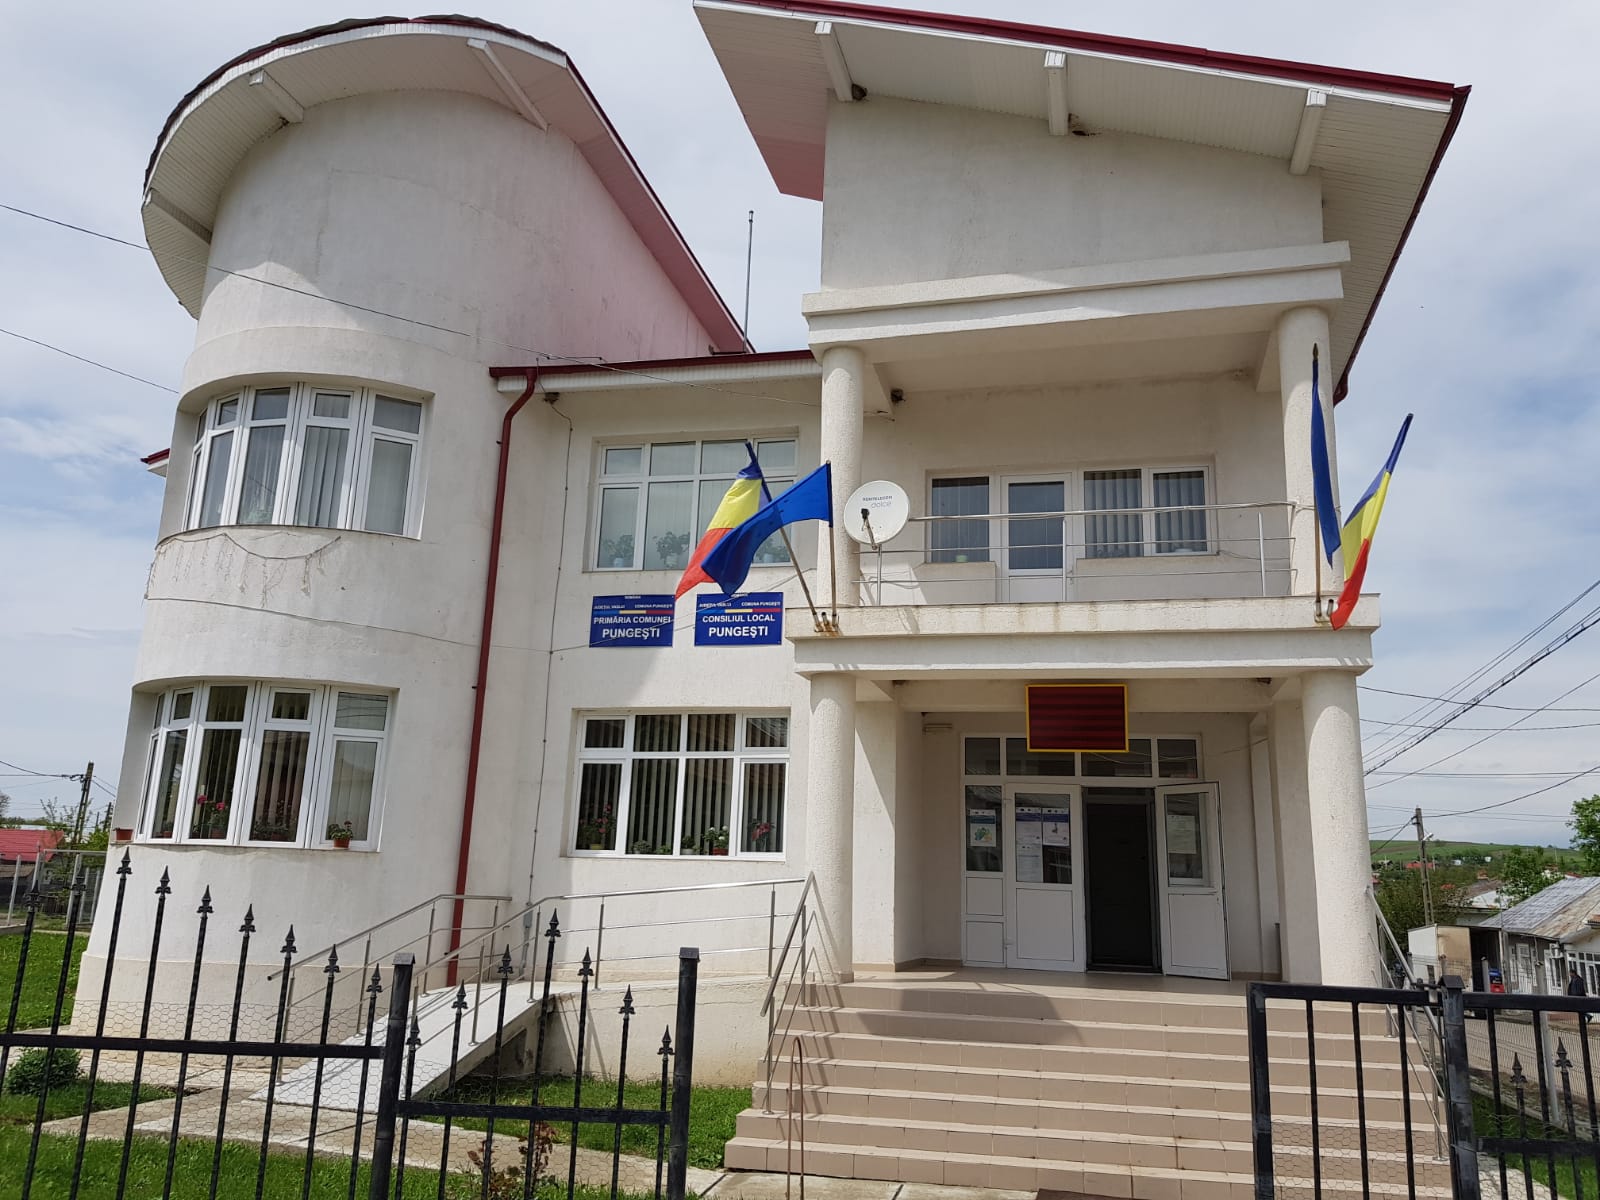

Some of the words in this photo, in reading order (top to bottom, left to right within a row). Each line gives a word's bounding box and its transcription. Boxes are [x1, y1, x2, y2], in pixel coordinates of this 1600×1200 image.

[593, 616, 631, 624] PRIMĂRIA
[702, 615, 745, 623] CONSILIUL
[747, 614, 775, 622] LOCAL
